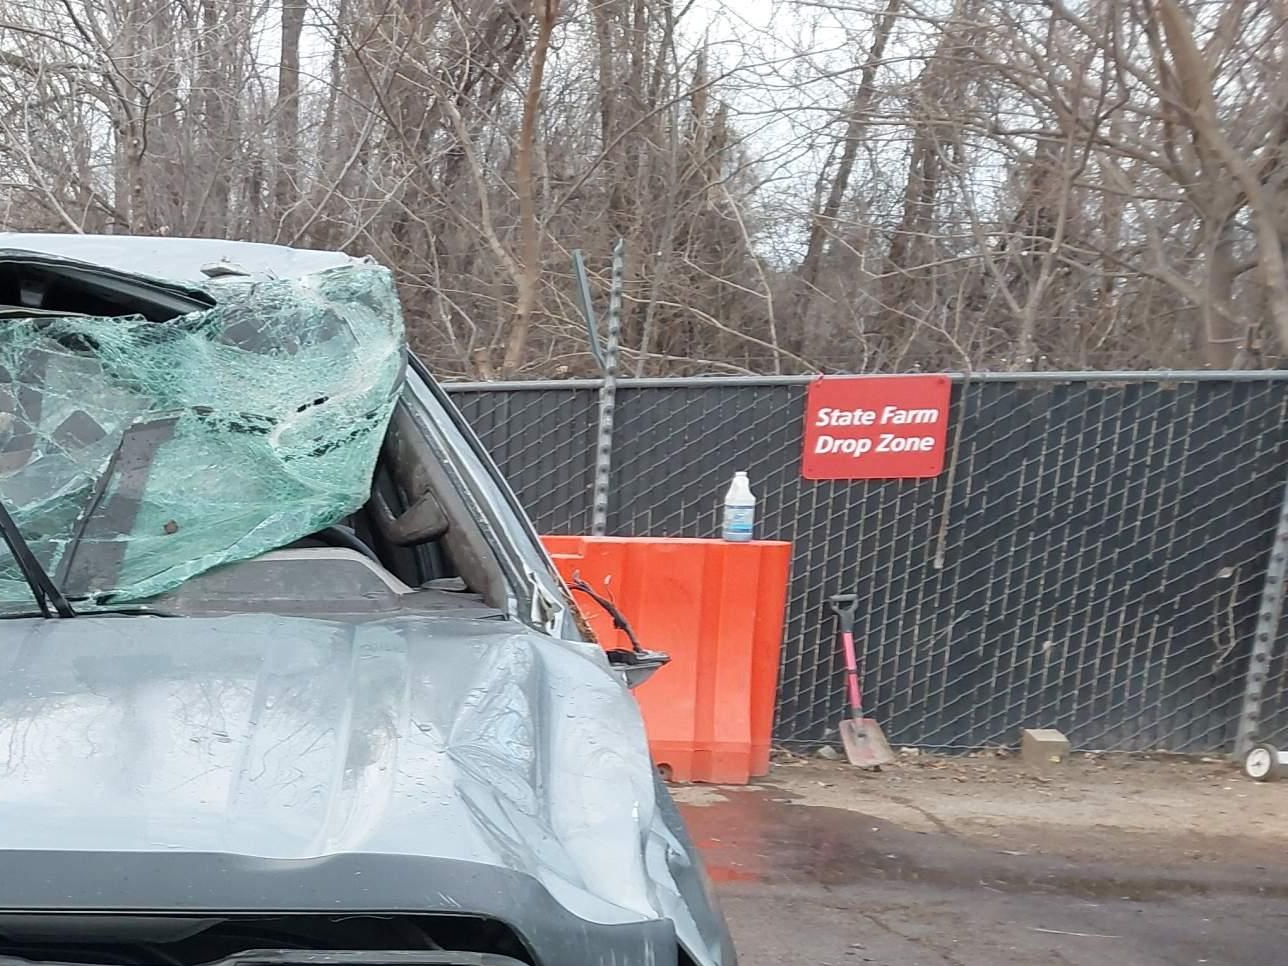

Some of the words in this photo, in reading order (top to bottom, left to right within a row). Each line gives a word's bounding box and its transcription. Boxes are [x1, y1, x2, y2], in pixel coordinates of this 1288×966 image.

[815, 407, 877, 427] State
[879, 405, 939, 425] Farm
[814, 435, 873, 458] Drop
[874, 433, 935, 453] Zone
